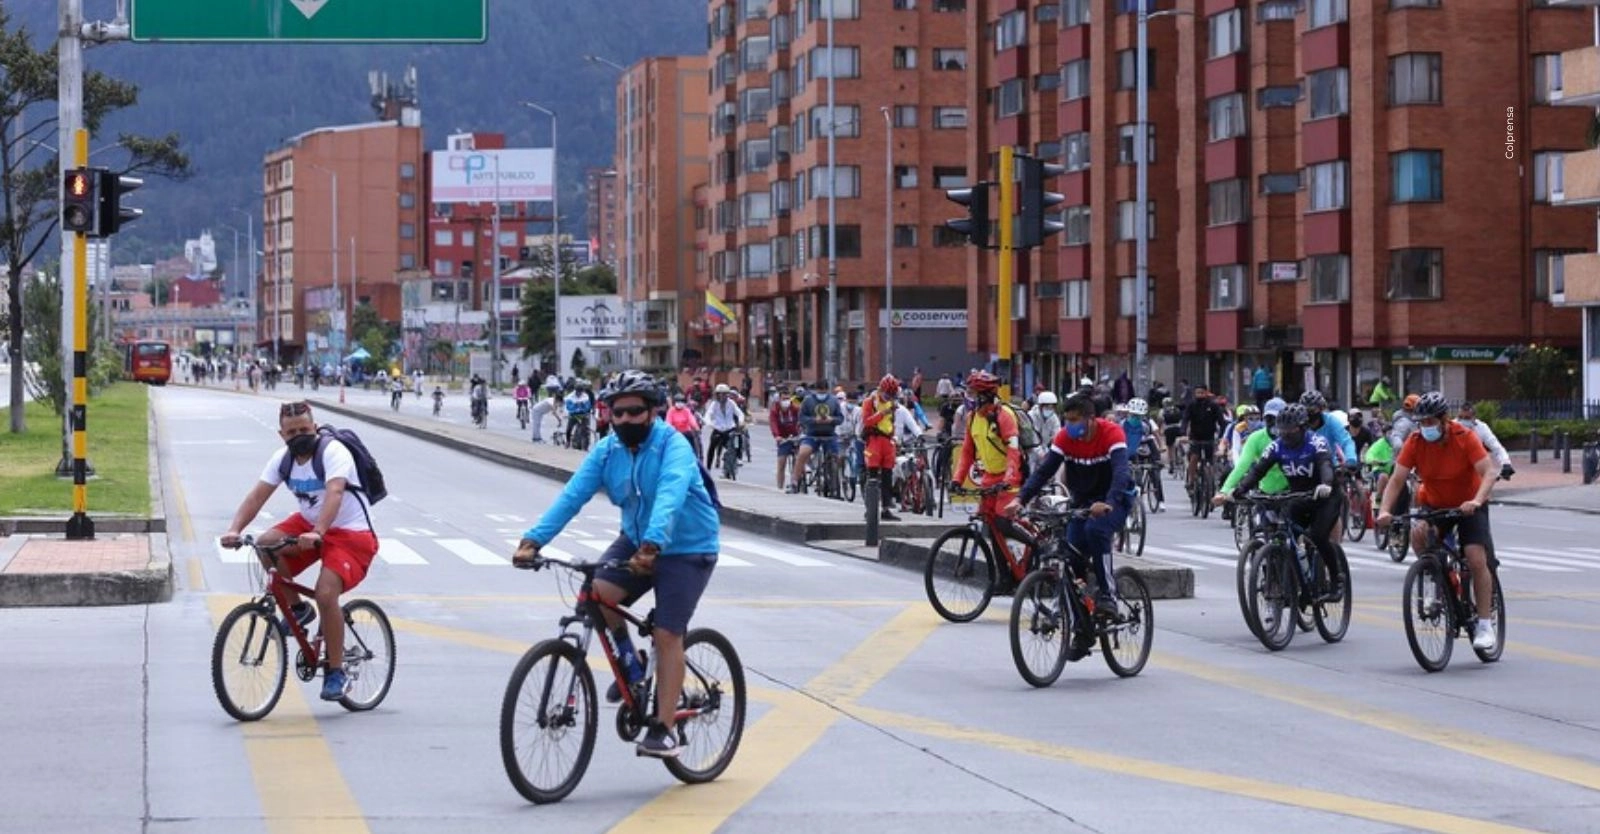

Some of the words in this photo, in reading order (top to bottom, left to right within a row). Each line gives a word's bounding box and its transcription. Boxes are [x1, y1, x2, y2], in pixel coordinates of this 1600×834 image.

[566, 316, 588, 325] SAN
[590, 316, 626, 325] PABLO
[1282, 460, 1314, 478] sky
